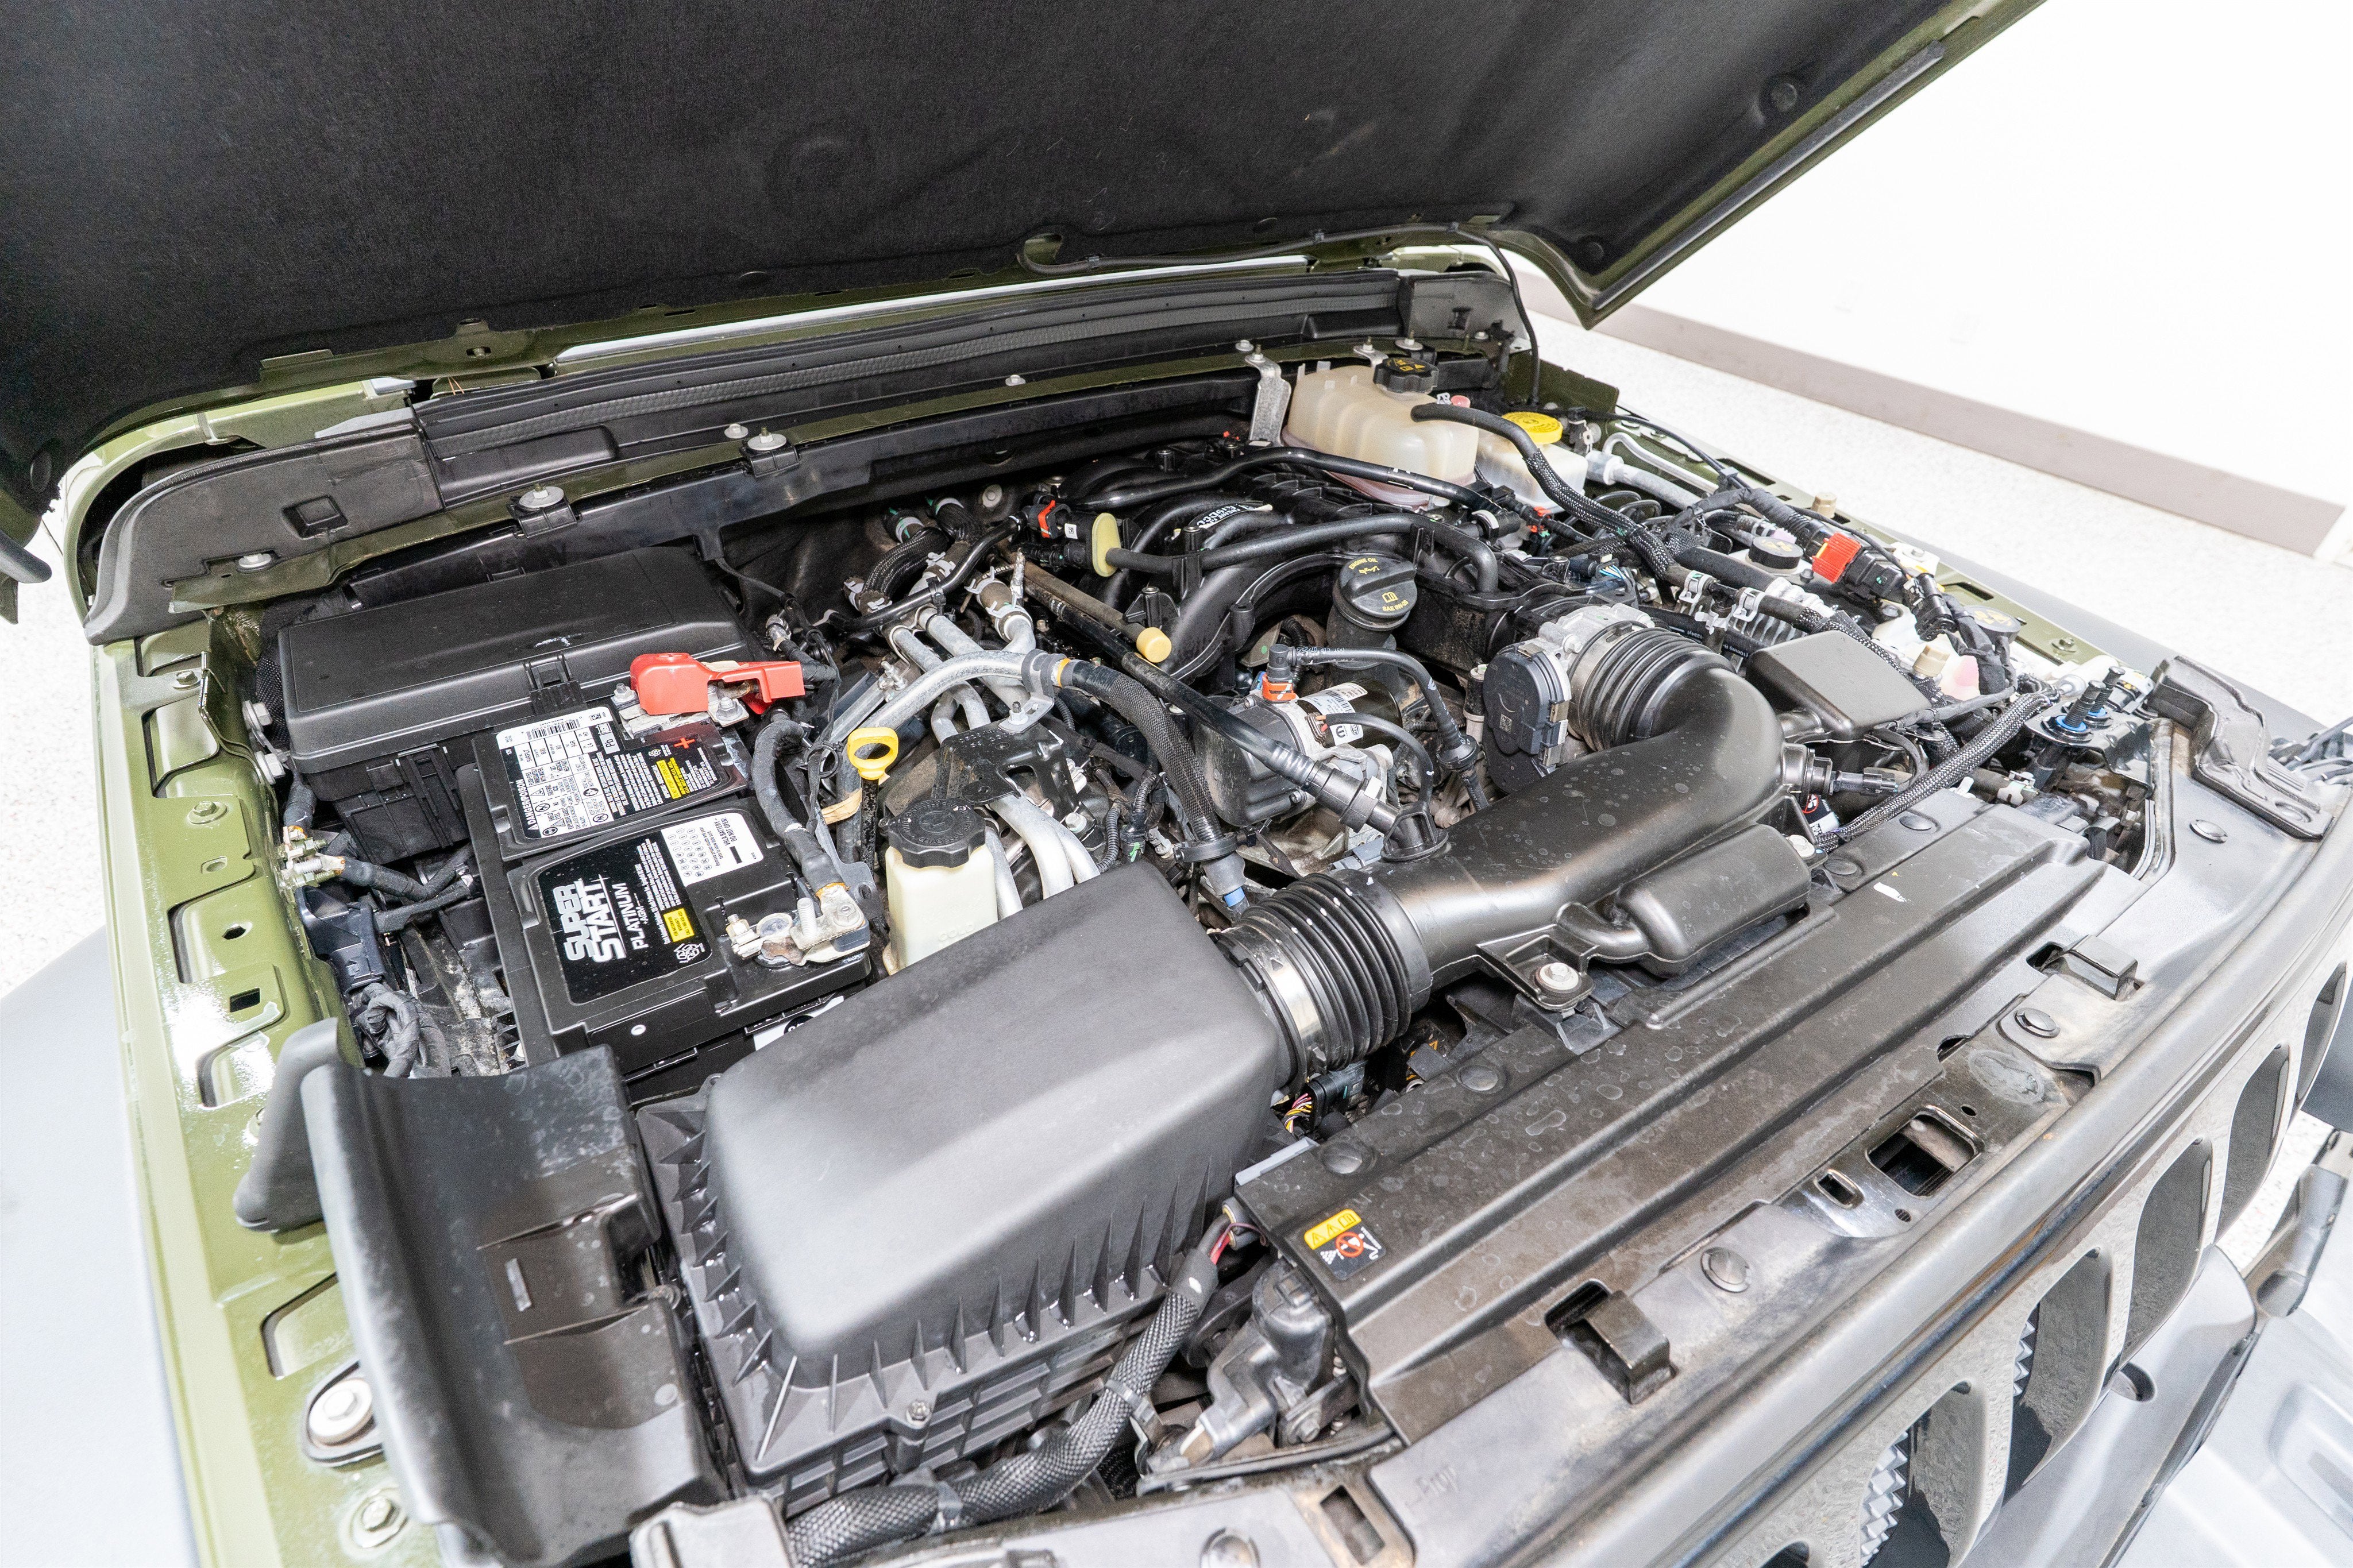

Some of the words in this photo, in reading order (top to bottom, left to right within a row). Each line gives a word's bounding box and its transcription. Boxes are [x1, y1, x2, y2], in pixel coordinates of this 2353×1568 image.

[1348, 558, 1368, 570] ENGINE
[1394, 600, 1409, 610] 0W-20
[603, 738, 615, 747] Pb
[523, 748, 533, 762] 94RPLT
[514, 778, 537, 825] DANGER/POISON
[564, 816, 574, 829] EXPLOSIVE
[713, 820, 726, 836] BATTERY
[720, 817, 730, 828] OPEN!
[726, 828, 734, 836] NOT
[721, 835, 731, 845] VRLA
[711, 854, 720, 866] Remove
[611, 882, 649, 949] PLATINUM
[635, 905, 649, 922] AGM
[552, 882, 596, 962] SUPER
[573, 879, 626, 963] START
[938, 922, 976, 942] COLD
